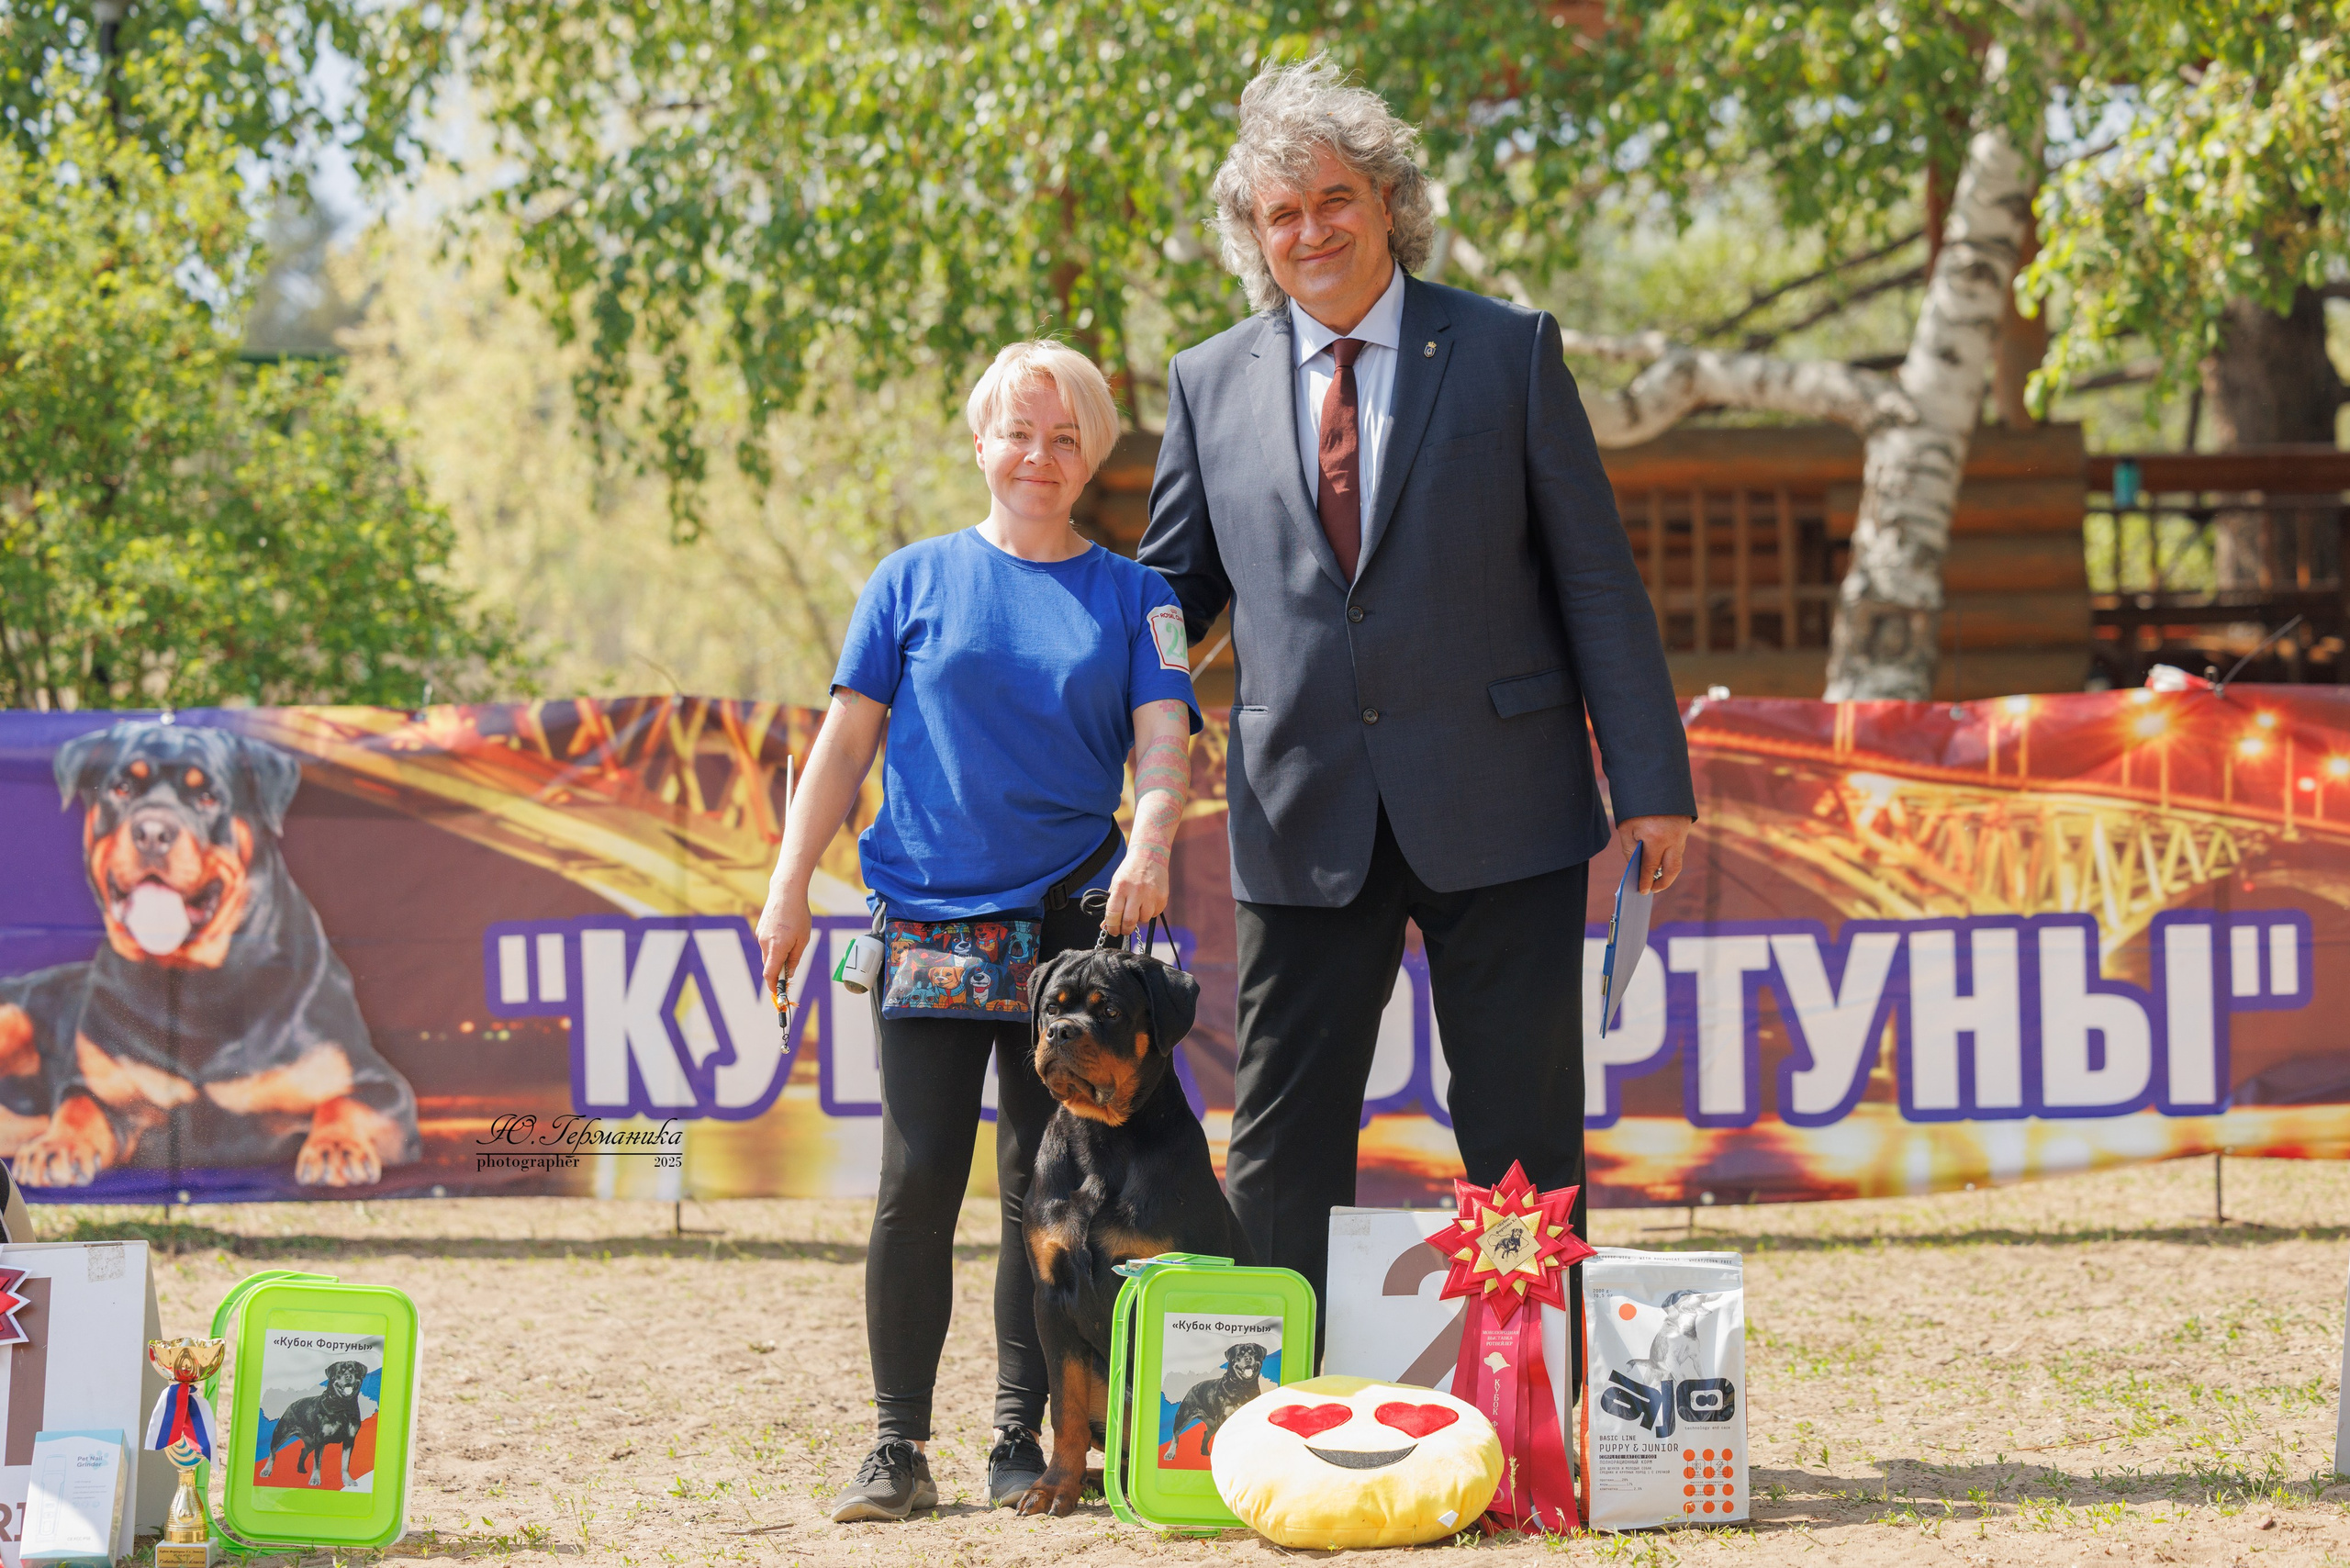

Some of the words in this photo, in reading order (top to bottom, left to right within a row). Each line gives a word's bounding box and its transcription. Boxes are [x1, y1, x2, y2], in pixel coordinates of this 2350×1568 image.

[1364, 924, 2299, 1114] РТУНЫ"
[1172, 1320, 1212, 1332] «Кубок
[1214, 1321, 1271, 1335] Фортуны»
[274, 1336, 313, 1350] «Кубок
[316, 1338, 373, 1352] Фортуны»
[1493, 1378, 1501, 1416] КУБОК
[1599, 1443, 1630, 1452] PUPPY
[1633, 1443, 1639, 1452] &
[1641, 1443, 1679, 1452] JUNIOR
